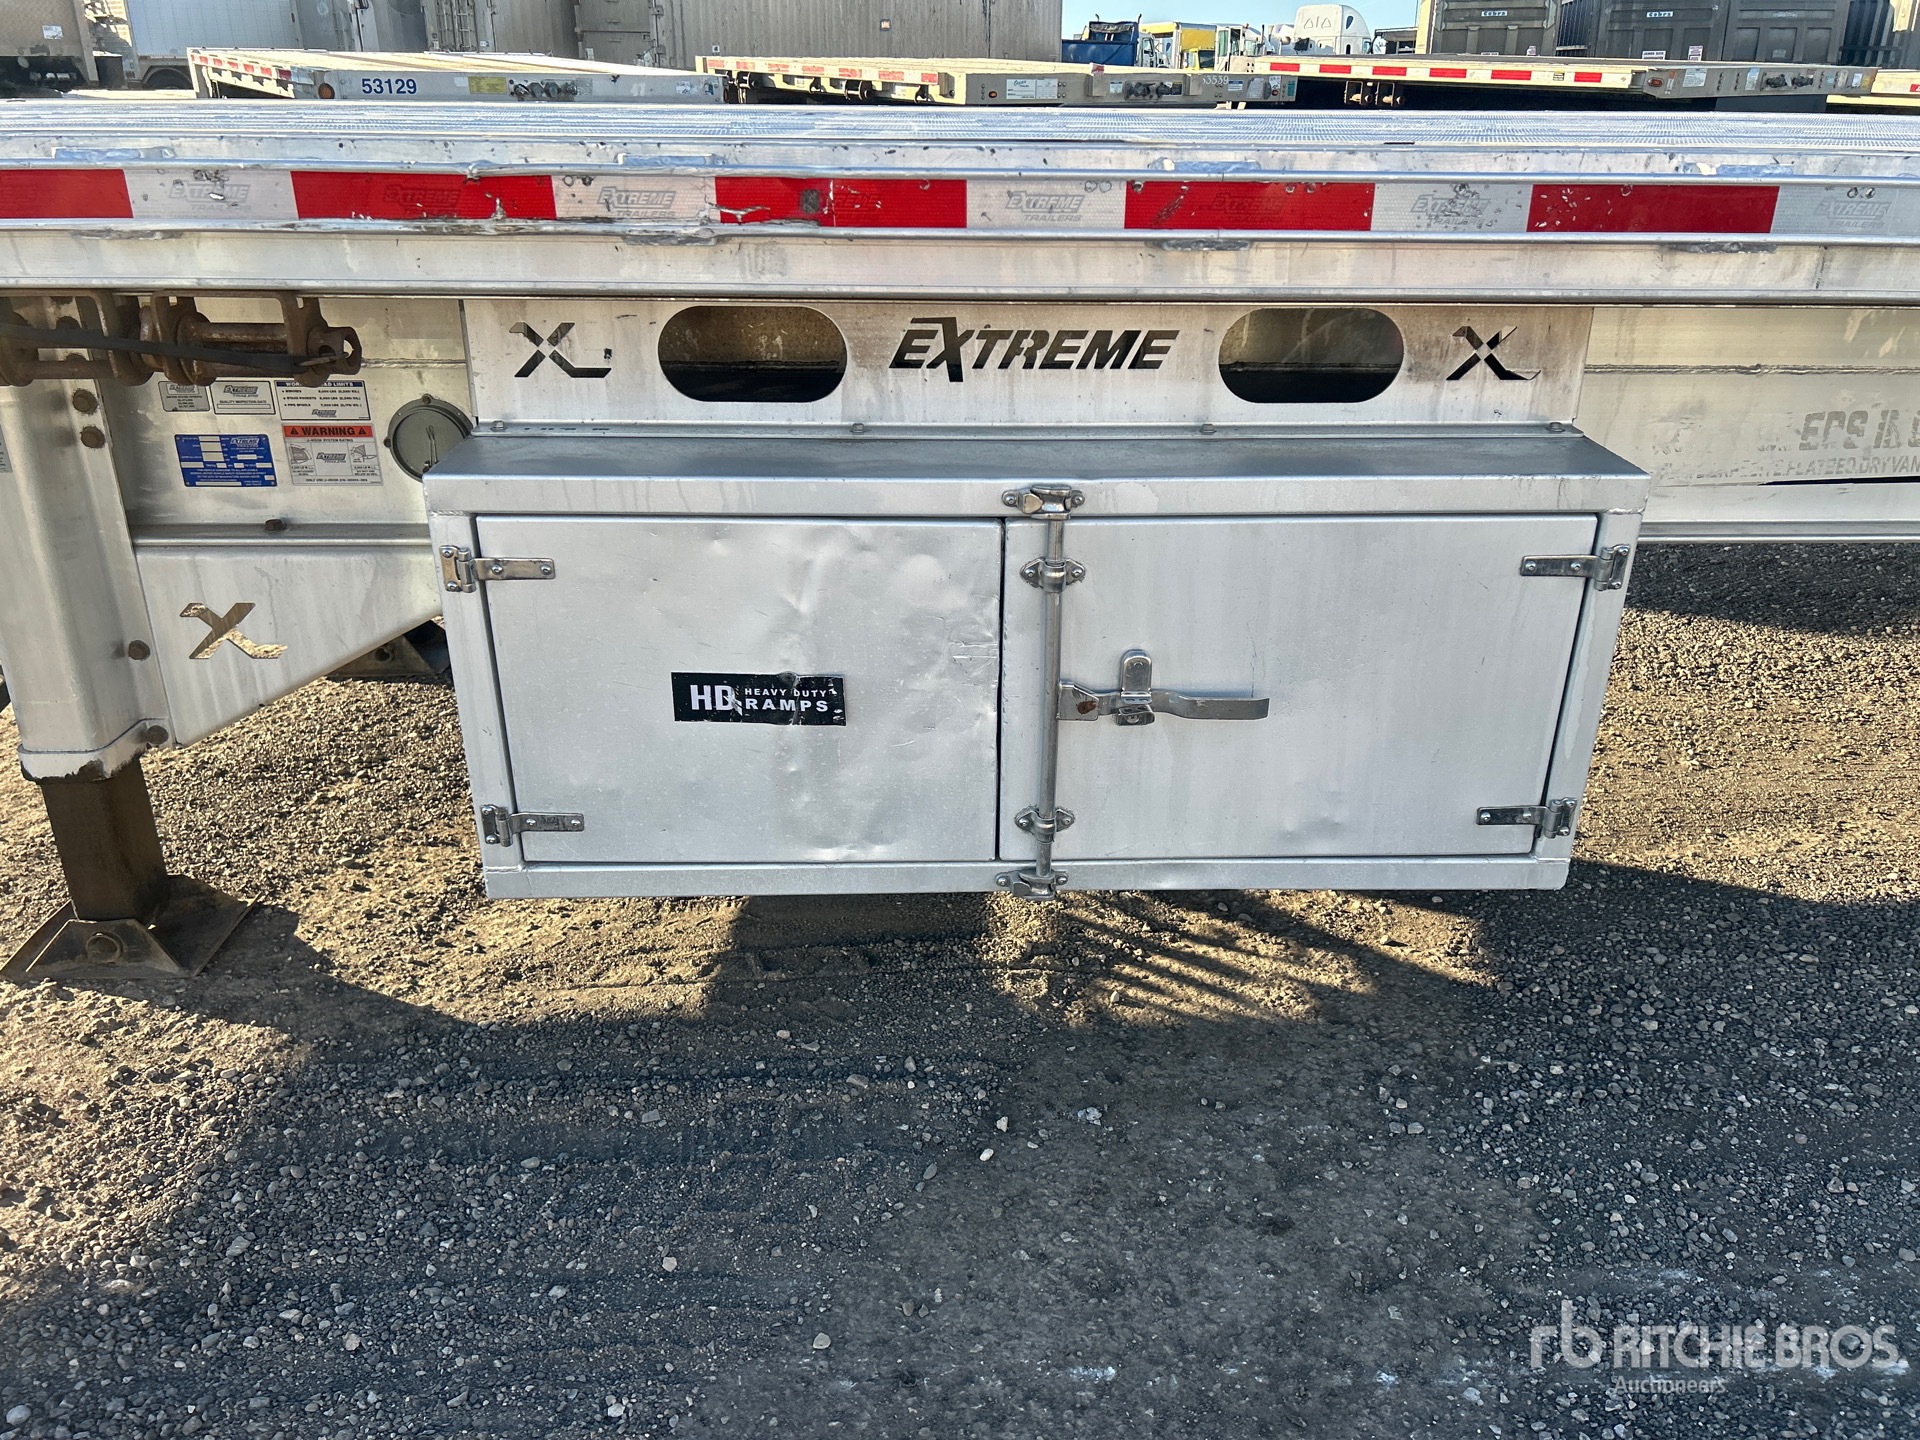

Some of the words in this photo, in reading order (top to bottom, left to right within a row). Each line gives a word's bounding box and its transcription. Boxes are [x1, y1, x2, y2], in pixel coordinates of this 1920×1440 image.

[361, 78, 417, 95] 53129
[597, 186, 677, 209] EXTREME
[1007, 191, 1085, 214] EXTREME
[888, 316, 1180, 383] EXTREME
[301, 427, 356, 436] WARNING
[690, 684, 742, 716] HD
[745, 688, 787, 697] HEAVY
[793, 688, 827, 698] DUTY
[745, 698, 829, 713] RAMPS
